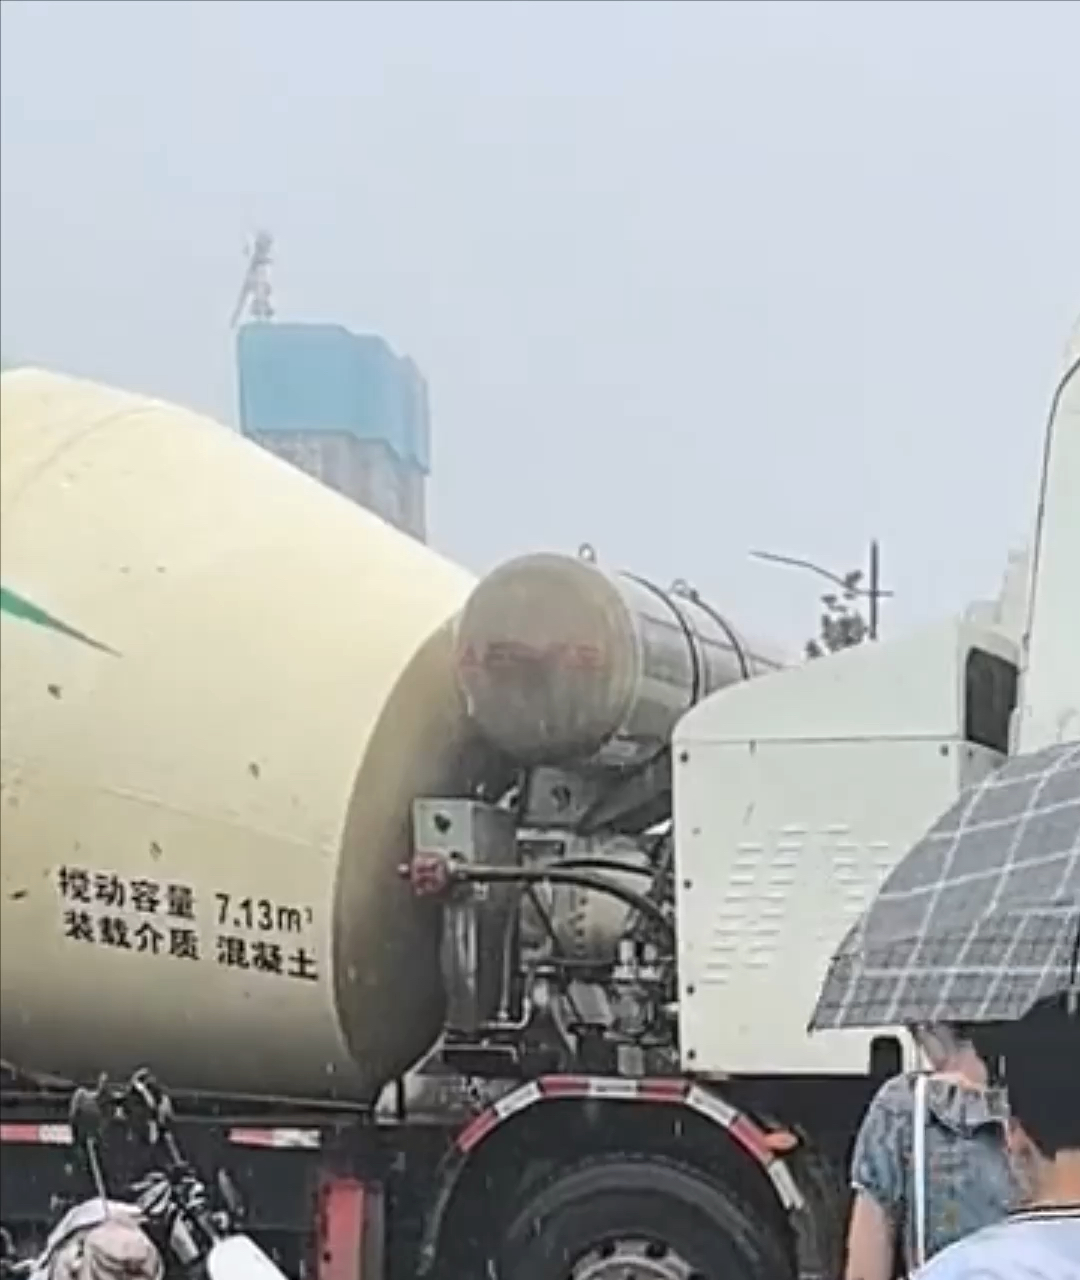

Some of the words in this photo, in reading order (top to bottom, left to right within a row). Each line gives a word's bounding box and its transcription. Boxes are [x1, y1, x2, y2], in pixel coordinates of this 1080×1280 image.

[58, 865, 196, 921] 搅动容量
[64, 909, 200, 961] 装载介质
[216, 934, 319, 981] 混凝土
